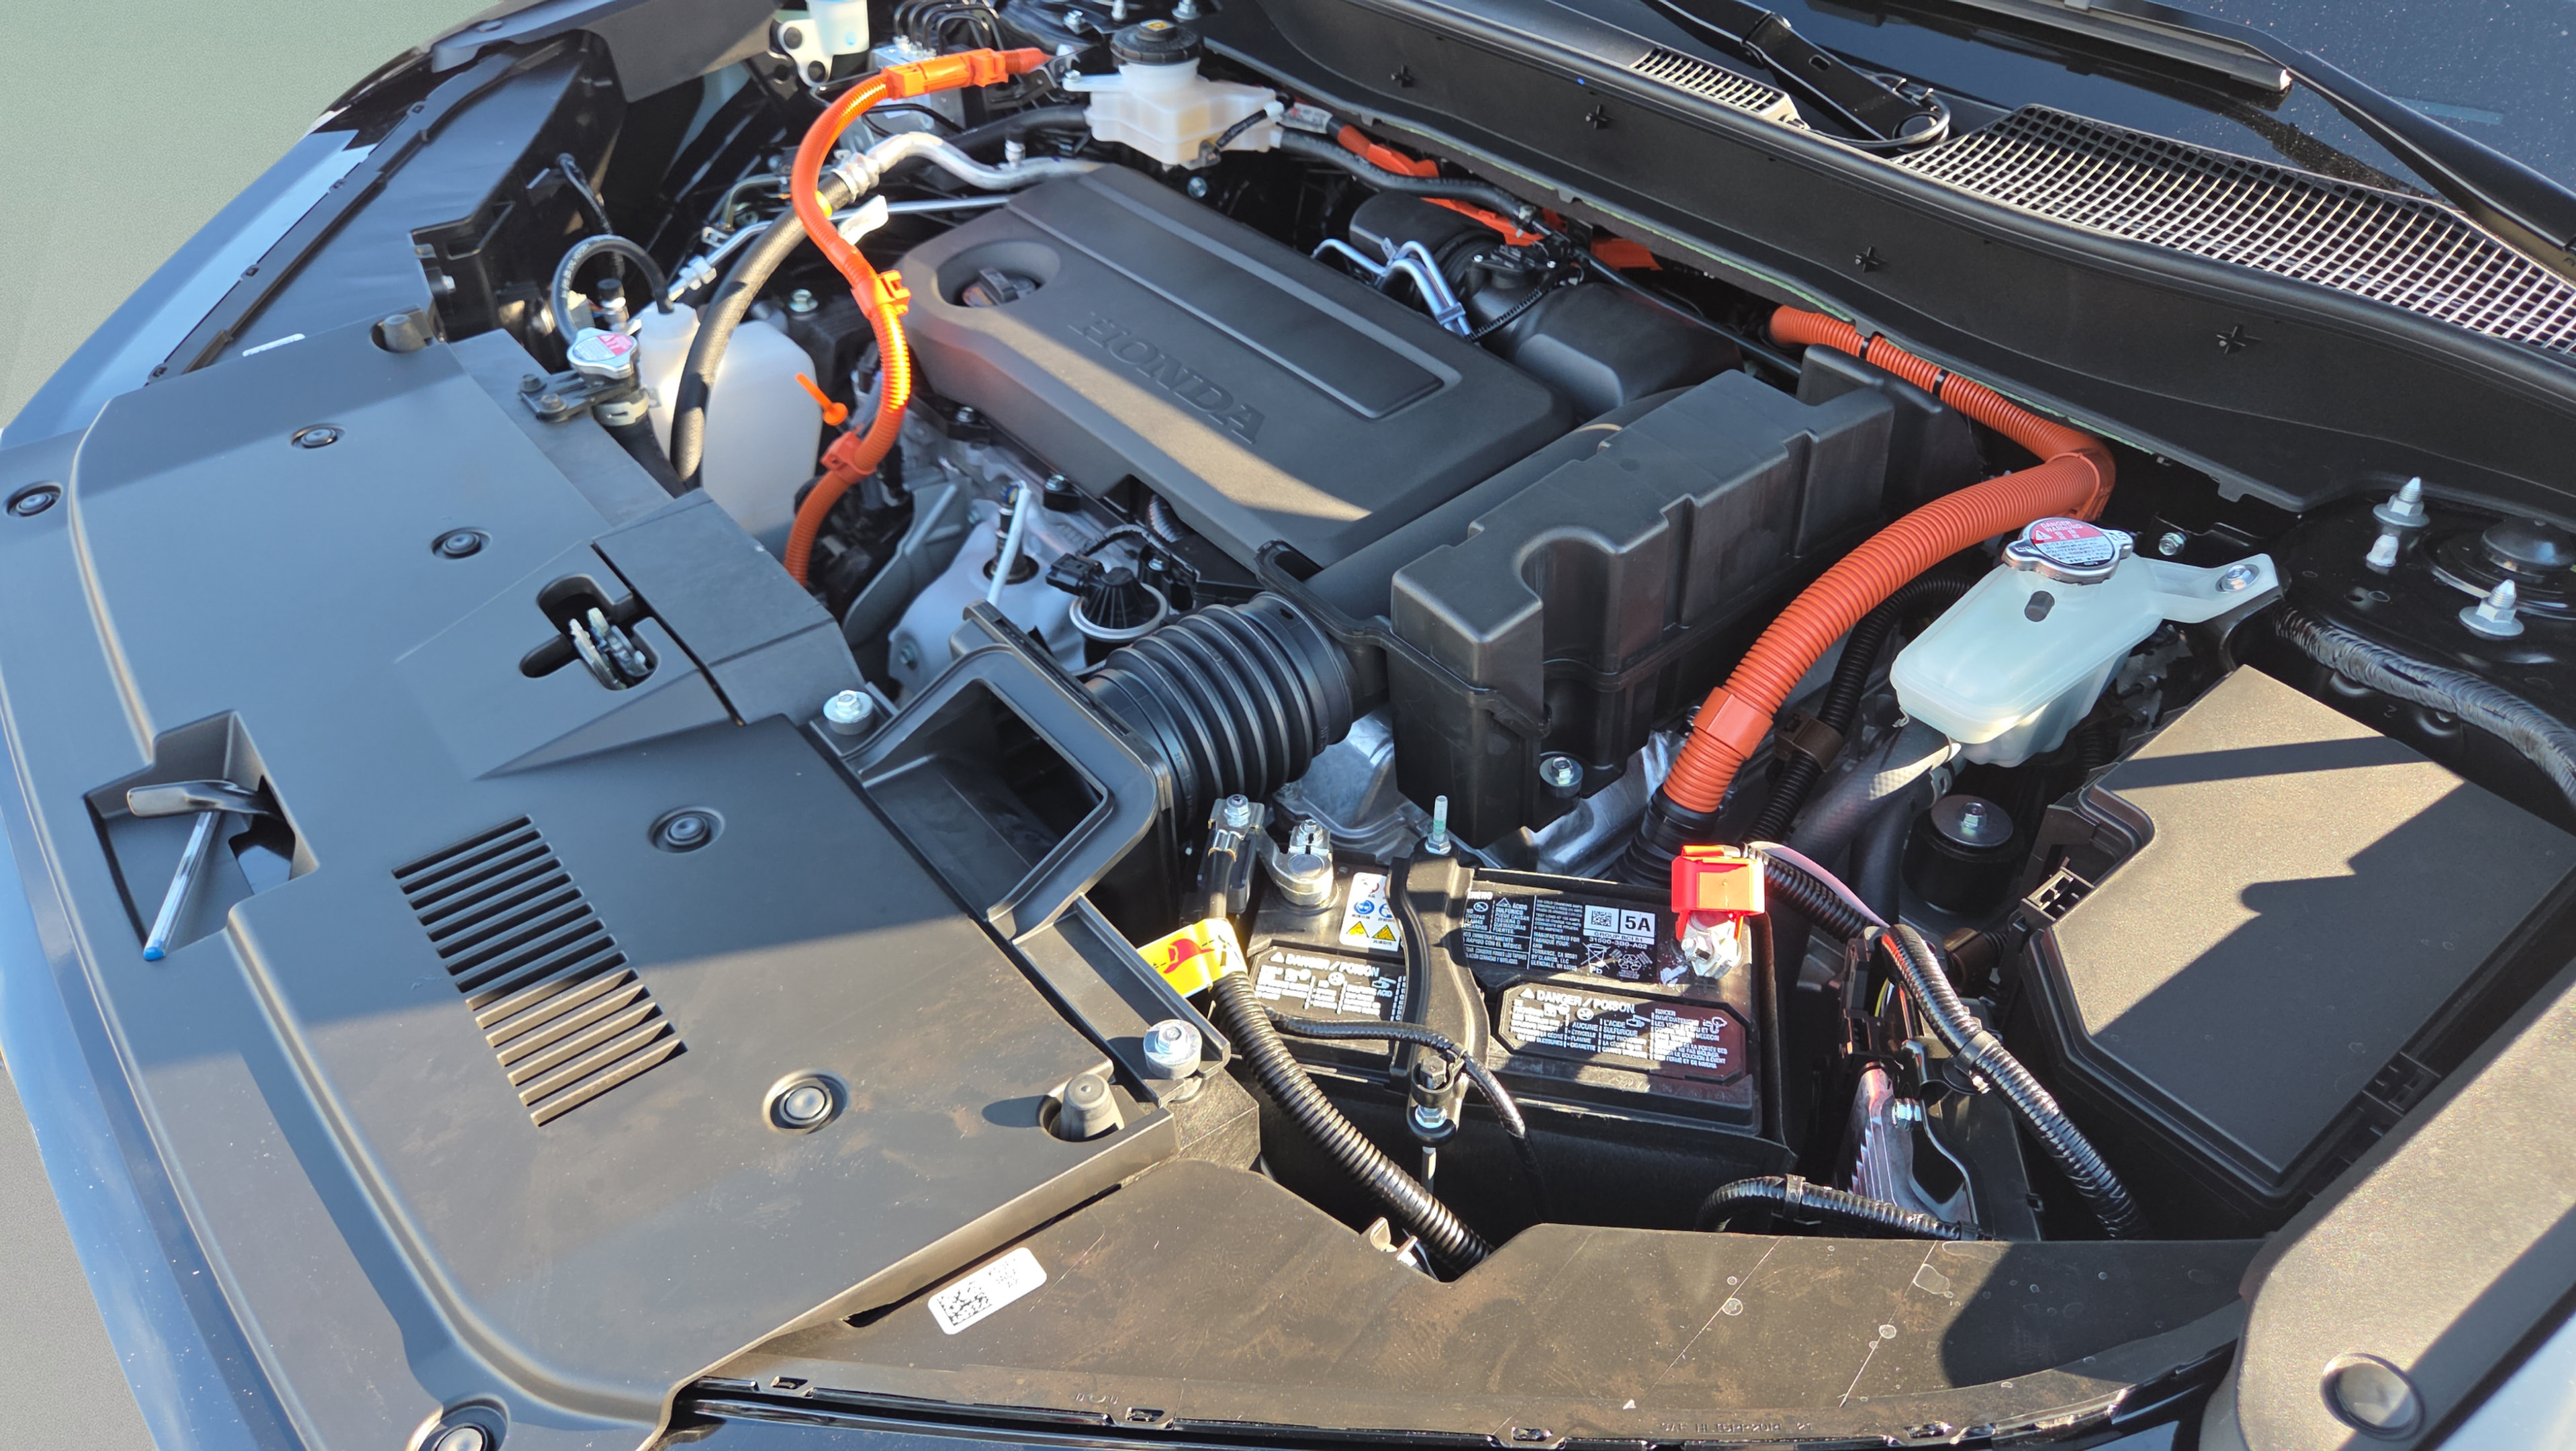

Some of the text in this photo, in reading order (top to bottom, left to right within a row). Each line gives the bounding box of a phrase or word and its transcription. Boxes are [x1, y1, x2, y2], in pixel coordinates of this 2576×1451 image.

[1068, 312, 1266, 445] HONDA
[1625, 916, 1651, 932] 5A
[1590, 966, 1602, 974] Pb
[1377, 990, 1393, 998] ACID
[1536, 990, 1581, 1007] DANGER
[1572, 1022, 1598, 1031] AUCUNE
[1604, 1019, 1626, 1028] L'ACIDE
[1603, 1026, 1638, 1037] SULFURIQUE
